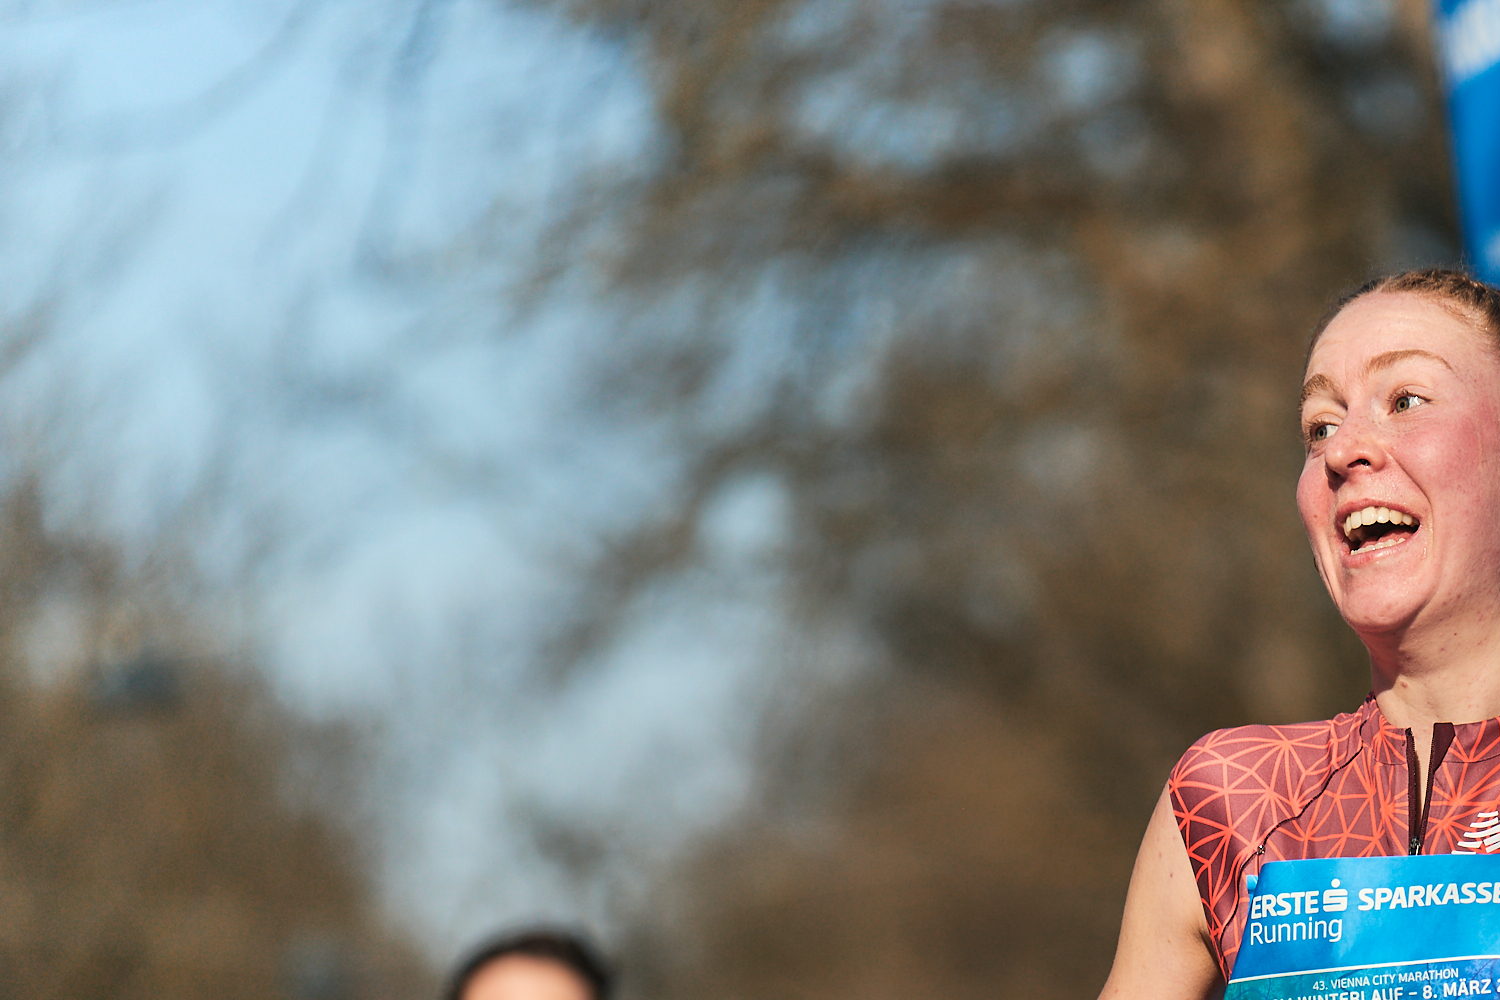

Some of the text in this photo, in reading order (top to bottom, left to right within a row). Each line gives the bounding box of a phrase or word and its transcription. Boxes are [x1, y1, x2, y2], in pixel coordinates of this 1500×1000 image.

[1250, 890, 1320, 920] ERSTE
[1250, 916, 1343, 946] Running
[1312, 967, 1459, 991] 43. VIENNA CITY MARATHON
[1422, 985, 1438, 999] 8.
[1443, 977, 1492, 997] MÄRZ
